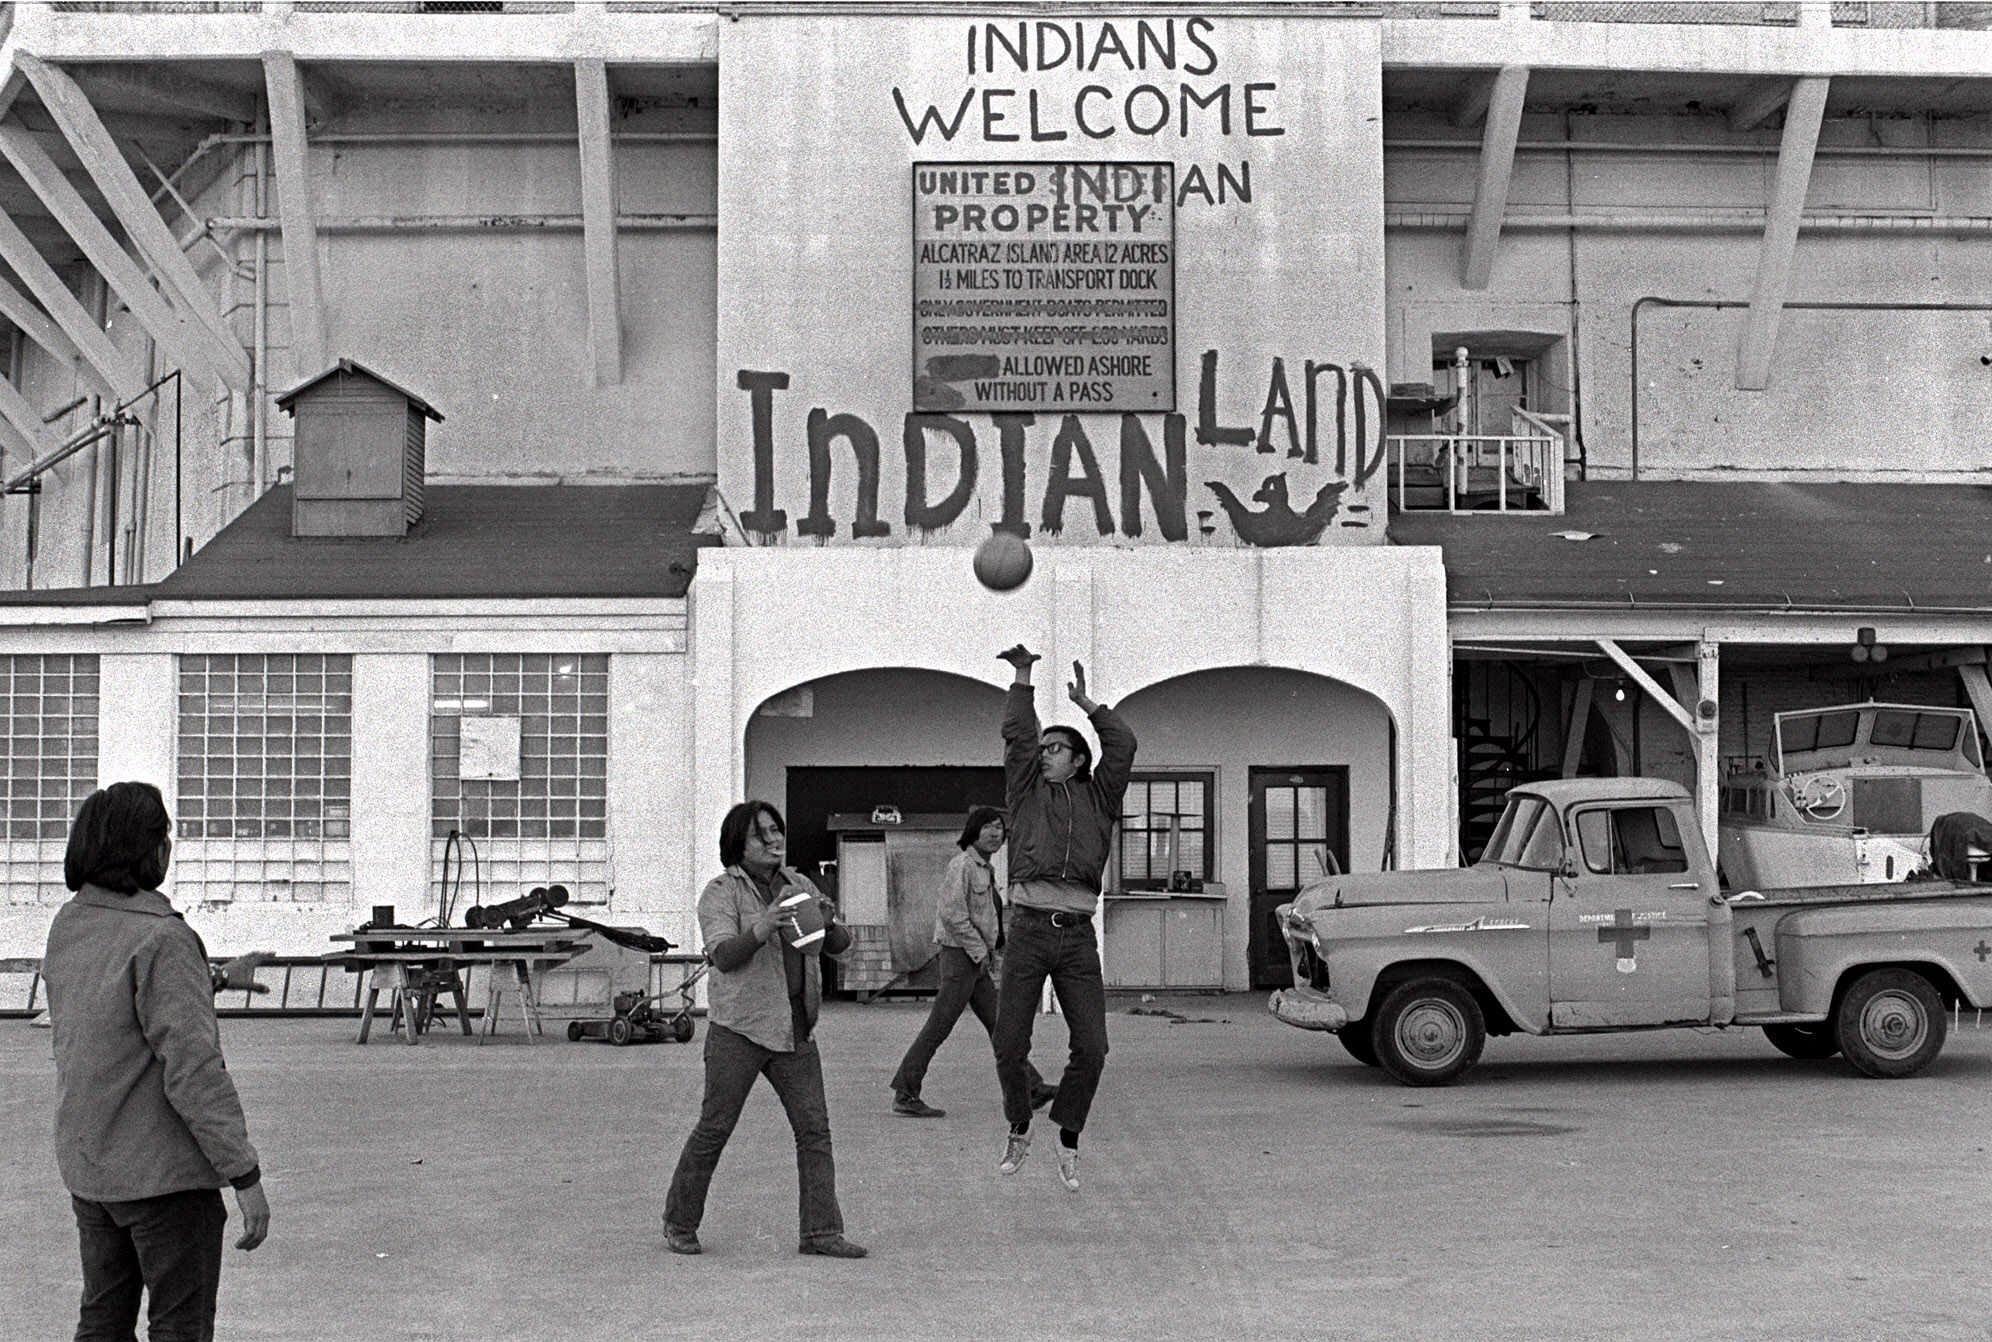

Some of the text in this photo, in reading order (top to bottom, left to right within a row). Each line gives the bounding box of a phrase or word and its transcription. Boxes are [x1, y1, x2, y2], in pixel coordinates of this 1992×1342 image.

[968, 17, 1219, 75] INDIANS
[892, 83, 1285, 146] WELCOME
[919, 171, 1035, 195] UNITED
[1055, 160, 1252, 207] INDIAN
[934, 203, 1152, 232] PROPERTY
[920, 242, 1169, 264] ALCATRAZ ISLAND AREA 12 ACRES
[956, 269, 1000, 289] MILES
[1003, 269, 1023, 289] TO
[1026, 269, 1116, 289] TRANSPORT
[1119, 269, 1158, 289] DOCK
[1003, 355, 1153, 376] ALLOWED ASHORE
[974, 381, 1114, 402] WITHOUT A PASS
